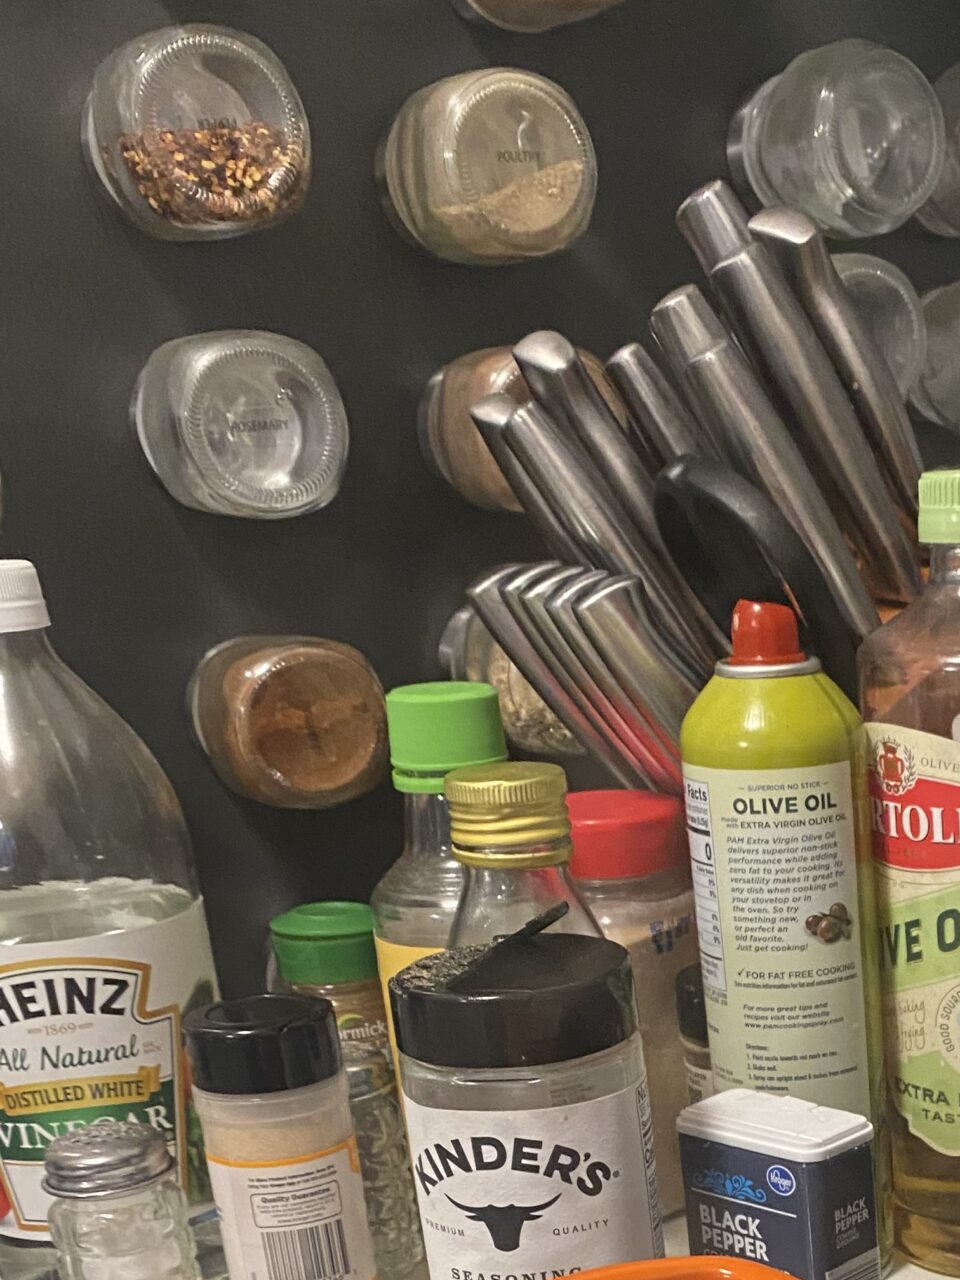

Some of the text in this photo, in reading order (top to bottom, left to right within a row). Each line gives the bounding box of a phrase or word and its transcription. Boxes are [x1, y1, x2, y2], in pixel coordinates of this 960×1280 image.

[921, 756, 960, 774] OLIVE
[748, 781, 820, 792] SUPERIOR NO STICK
[733, 792, 837, 815] OLIVE OIL
[741, 821, 771, 829] EXTRA
[773, 819, 806, 829] VIRGIN
[808, 816, 833, 826] OLIVE
[727, 836, 744, 844] PAM
[747, 836, 769, 845] Extra
[773, 836, 799, 845] Virgin
[801, 834, 823, 842] Olive
[728, 841, 838, 856] delivers superior non-stick
[728, 852, 838, 866] performance while adding
[730, 876, 770, 886] versatility
[773, 876, 801, 884] makes
[804, 875, 810, 883] it
[812, 871, 833, 882] great
[749, 866, 760, 875] fat
[763, 867, 772, 875] to
[775, 867, 794, 876] your
[731, 887, 744, 895] any
[747, 887, 765, 895] dish
[767, 886, 791, 894] when
[793, 883, 826, 893] cooking
[752, 895, 790, 905] stovetop
[804, 894, 812, 902] in
[733, 905, 745, 913] the
[773, 906, 783, 914] So
[787, 906, 799, 914] try
[733, 915, 776, 924] something
[744, 925, 775, 934] perfect
[735, 934, 748, 942] old
[736, 943, 809, 953] Just get cooking!
[746, 962, 856, 980] FOR FAT FREE COOKING
[777, 1004, 797, 1013] great
[44, 1022, 77, 1036] 1869
[940, 1023, 956, 1053] GOOD
[41, 1034, 139, 1070] Natural
[5, 1080, 145, 1110] DISTILLED WHITE
[415, 1136, 611, 1197] KINDER'S
[770, 1168, 793, 1191] Kroger
[834, 1196, 867, 1221] BLACK
[425, 1217, 610, 1237] PREMIUM QUALITY
[700, 1203, 763, 1238] BLACK
[835, 1208, 869, 1234] PEPPER
[701, 1225, 769, 1262] PEPPER
